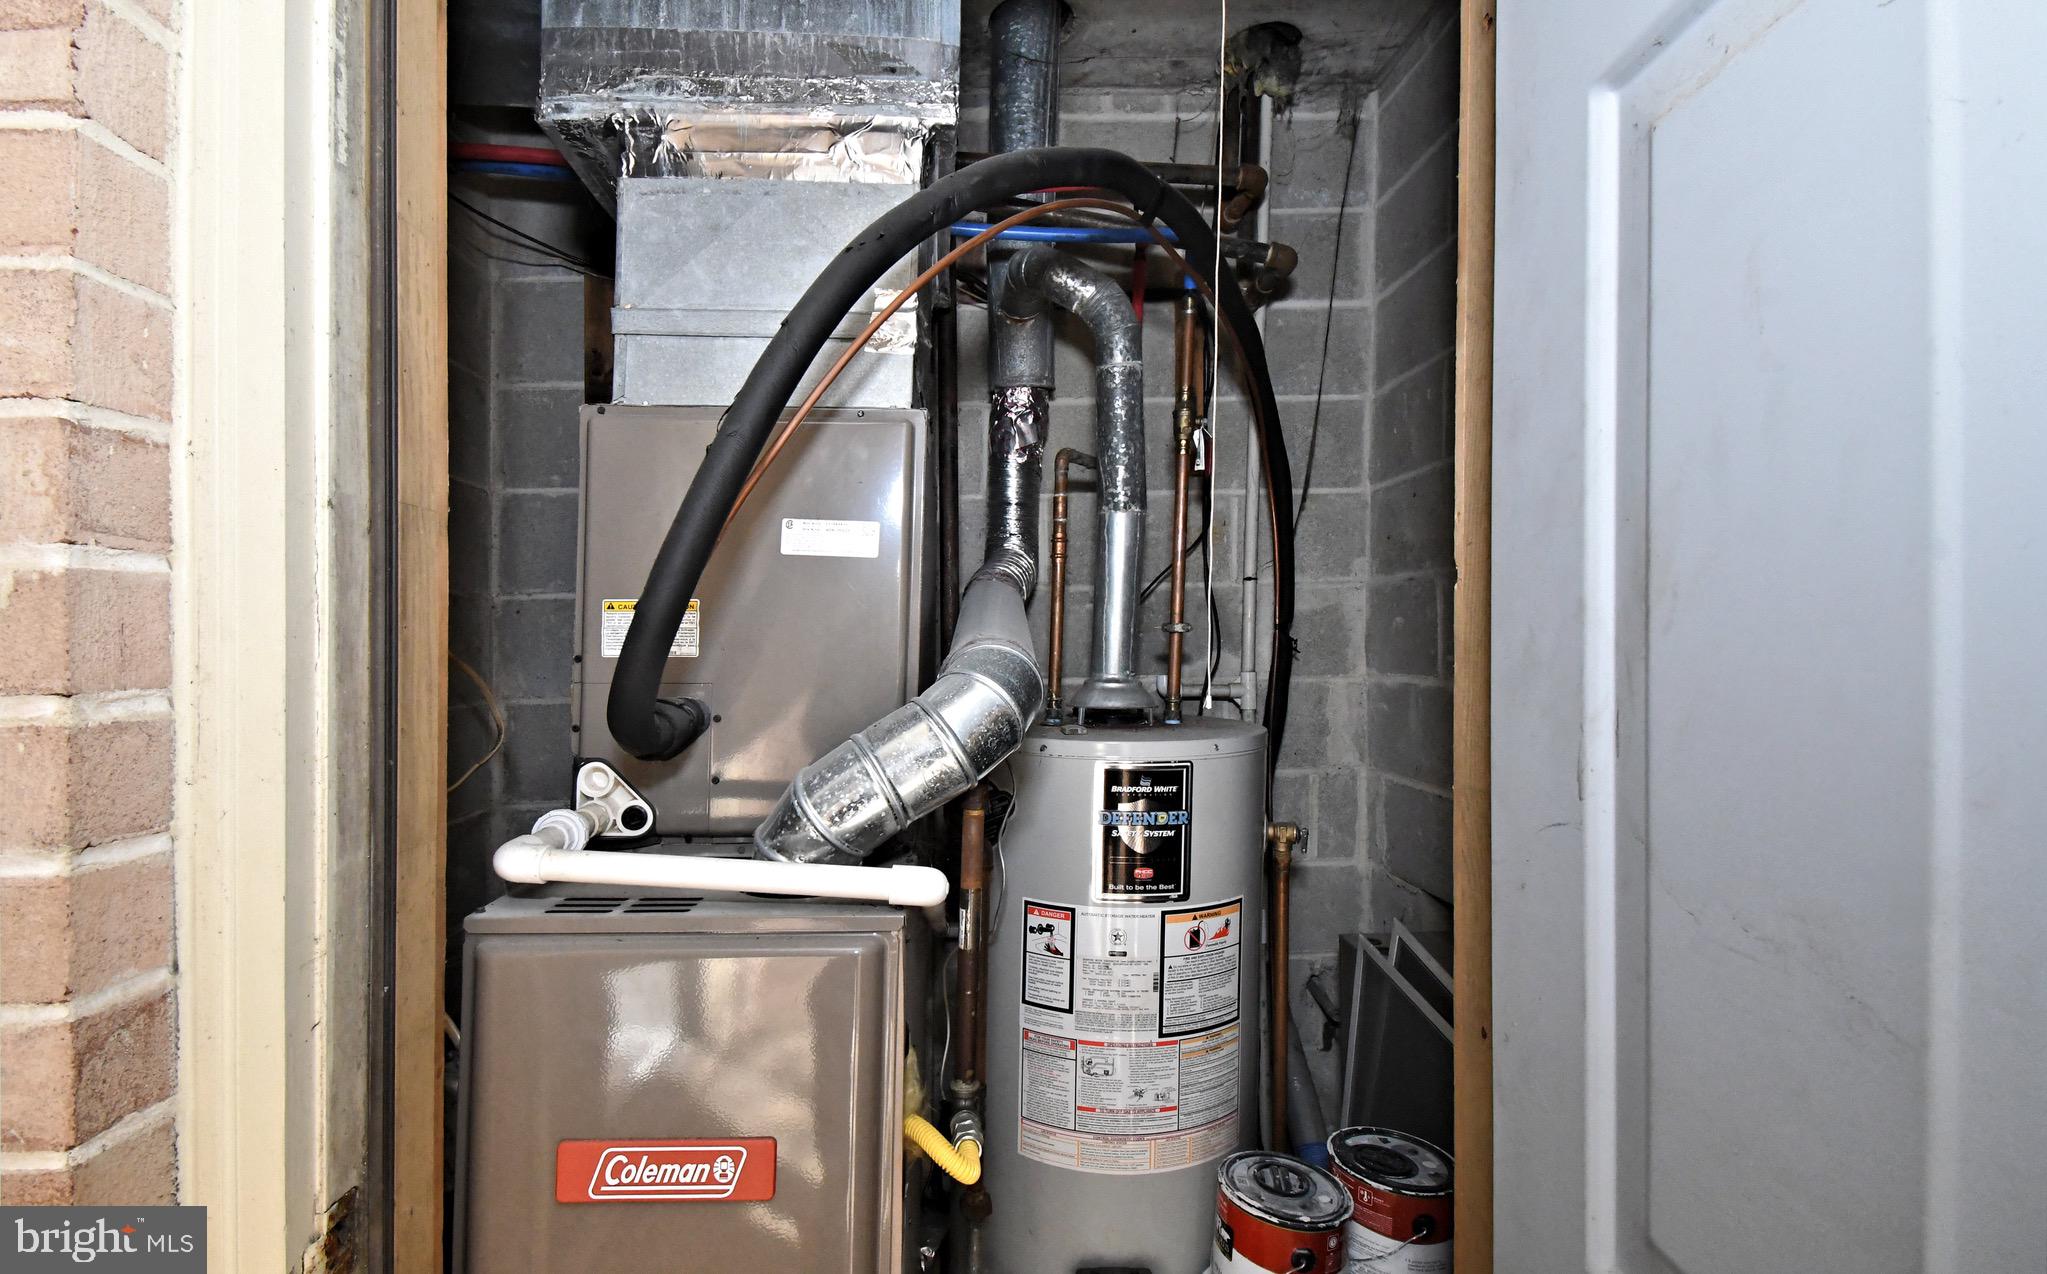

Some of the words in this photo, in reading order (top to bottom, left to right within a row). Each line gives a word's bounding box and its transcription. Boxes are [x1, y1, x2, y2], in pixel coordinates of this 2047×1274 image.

[1111, 785, 1152, 793] BRADFORD
[1154, 785, 1178, 793] WHITE
[1099, 810, 1189, 826] DEFENDER
[1143, 829, 1175, 837] SYSTEM
[1108, 883, 1125, 891] Built
[1040, 910, 1065, 919] DANGER
[1198, 910, 1222, 919] WARNING
[605, 1155, 711, 1186] Coleman
